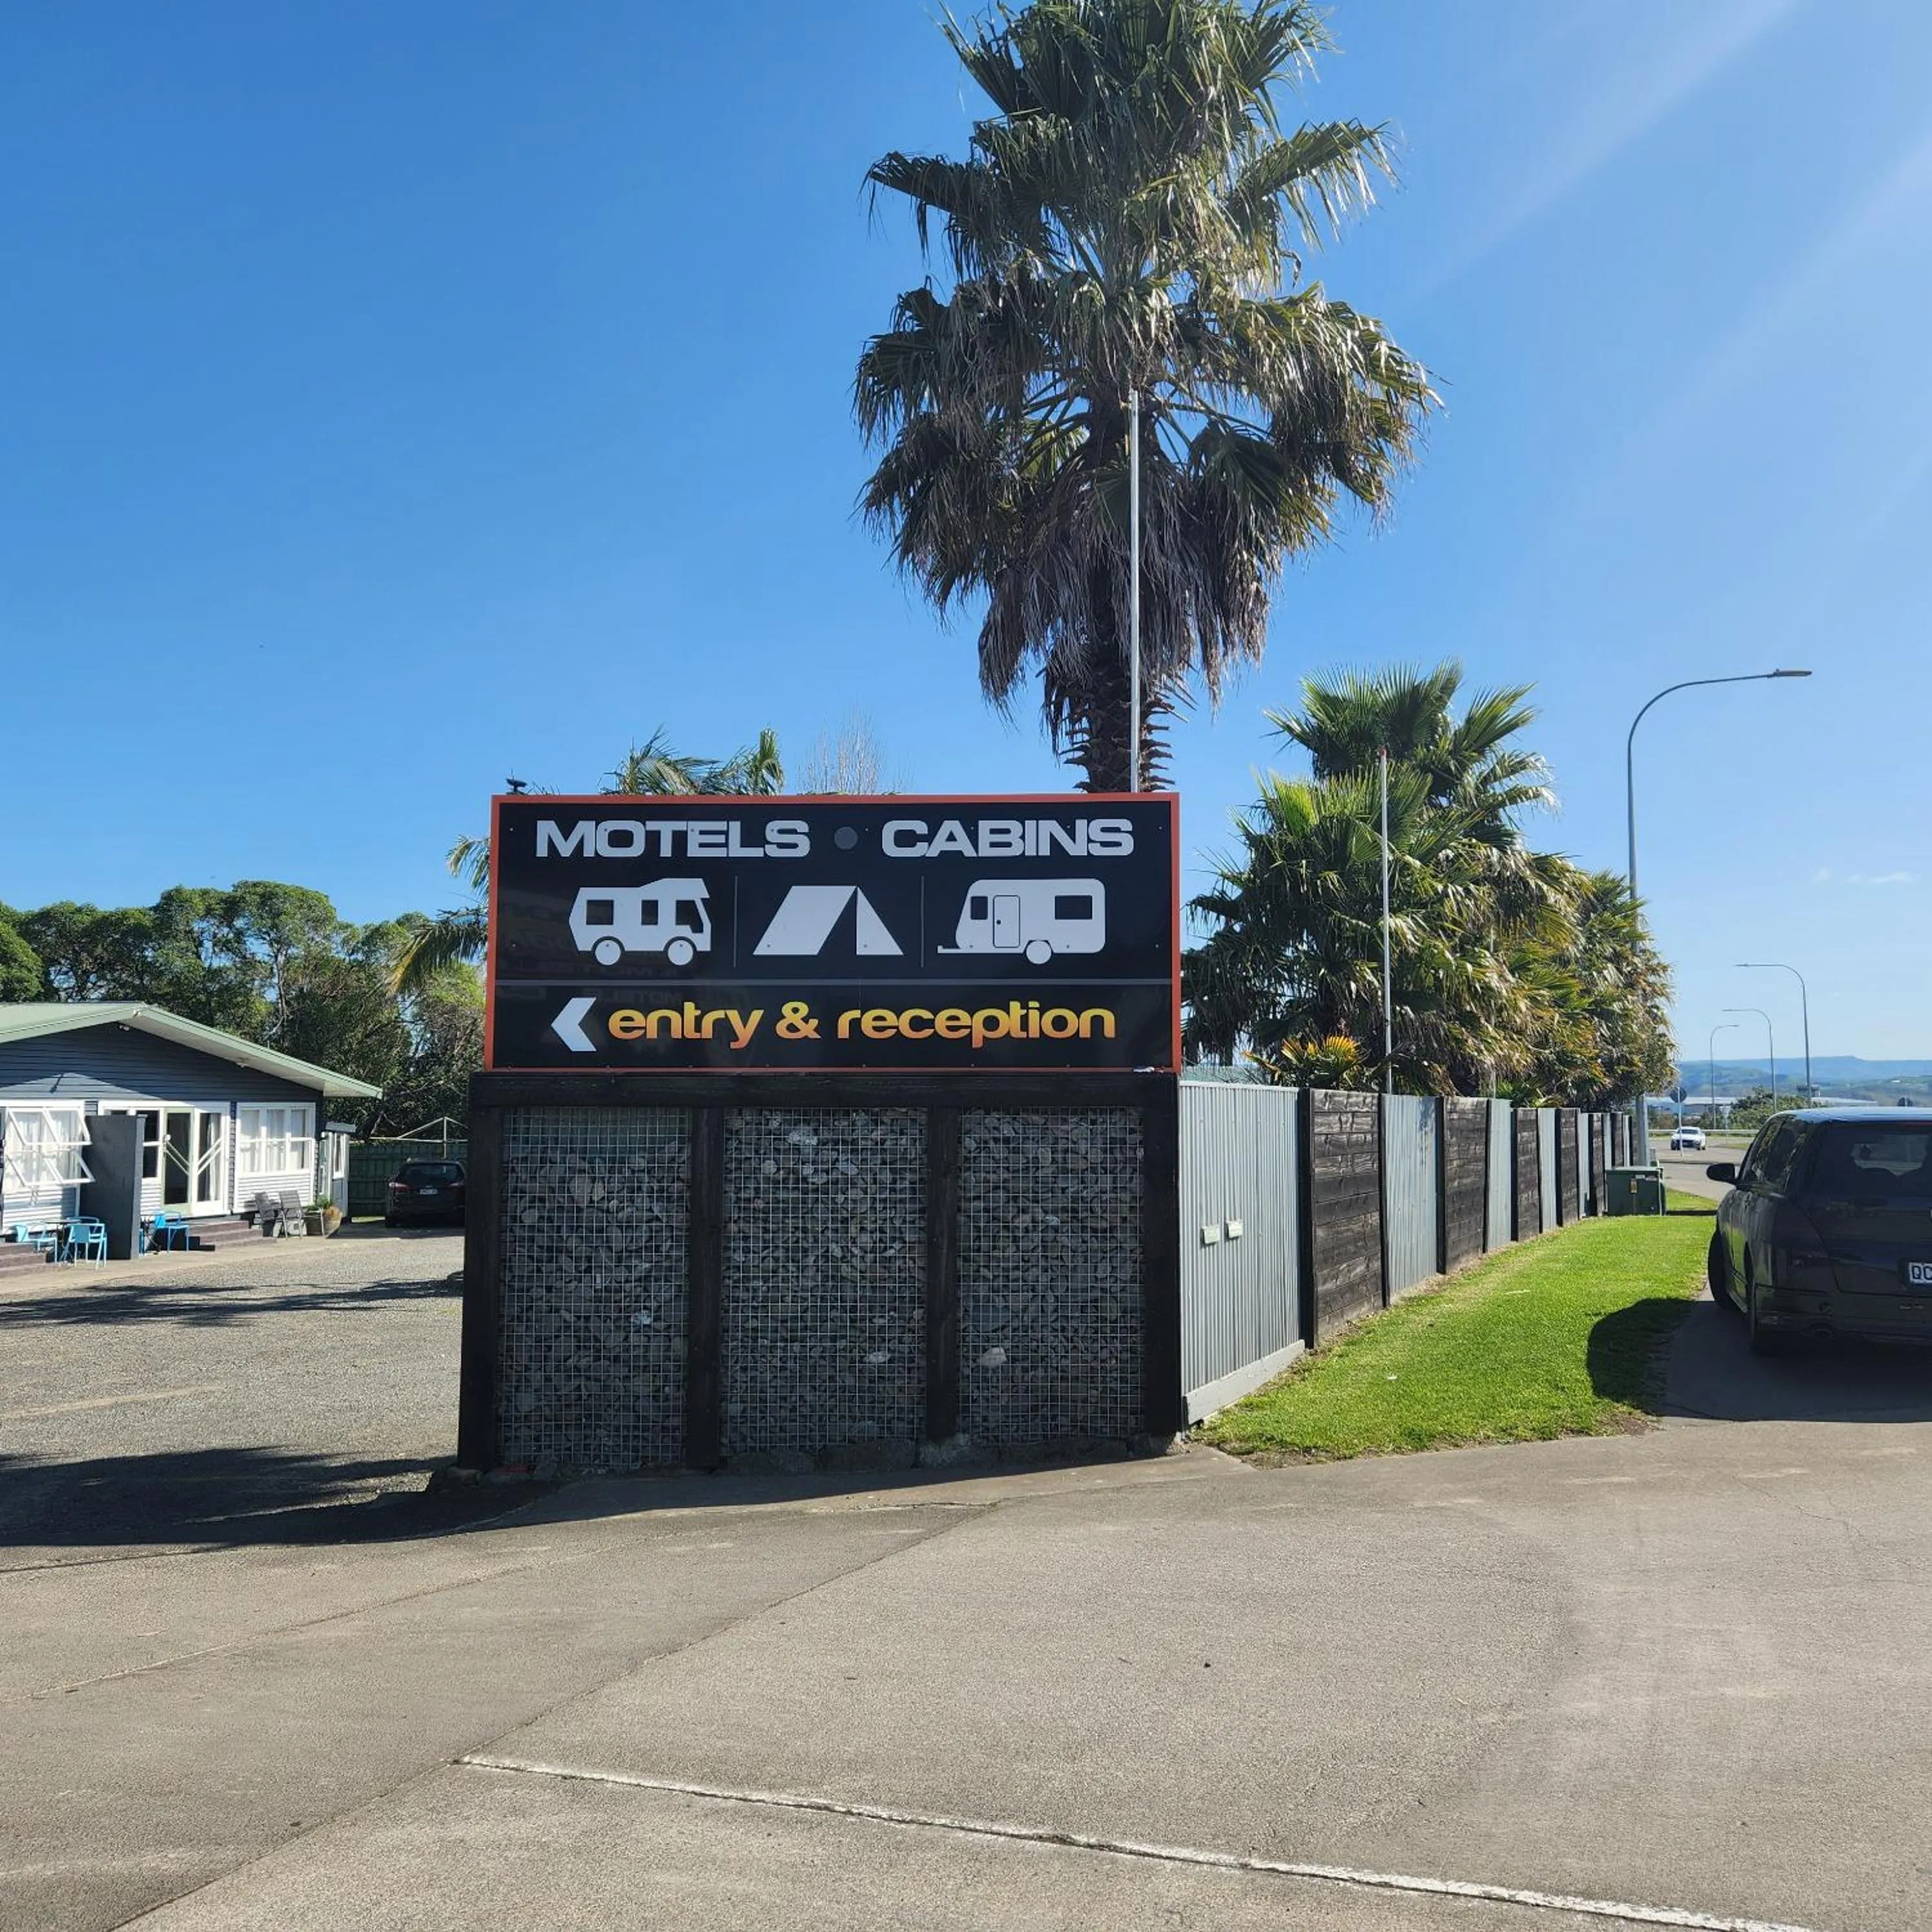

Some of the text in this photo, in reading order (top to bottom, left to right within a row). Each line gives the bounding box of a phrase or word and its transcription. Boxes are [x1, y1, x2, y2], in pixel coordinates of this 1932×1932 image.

[536, 818, 1135, 858] MOTELS CABINS
[608, 1001, 1116, 1049] entry & reception
